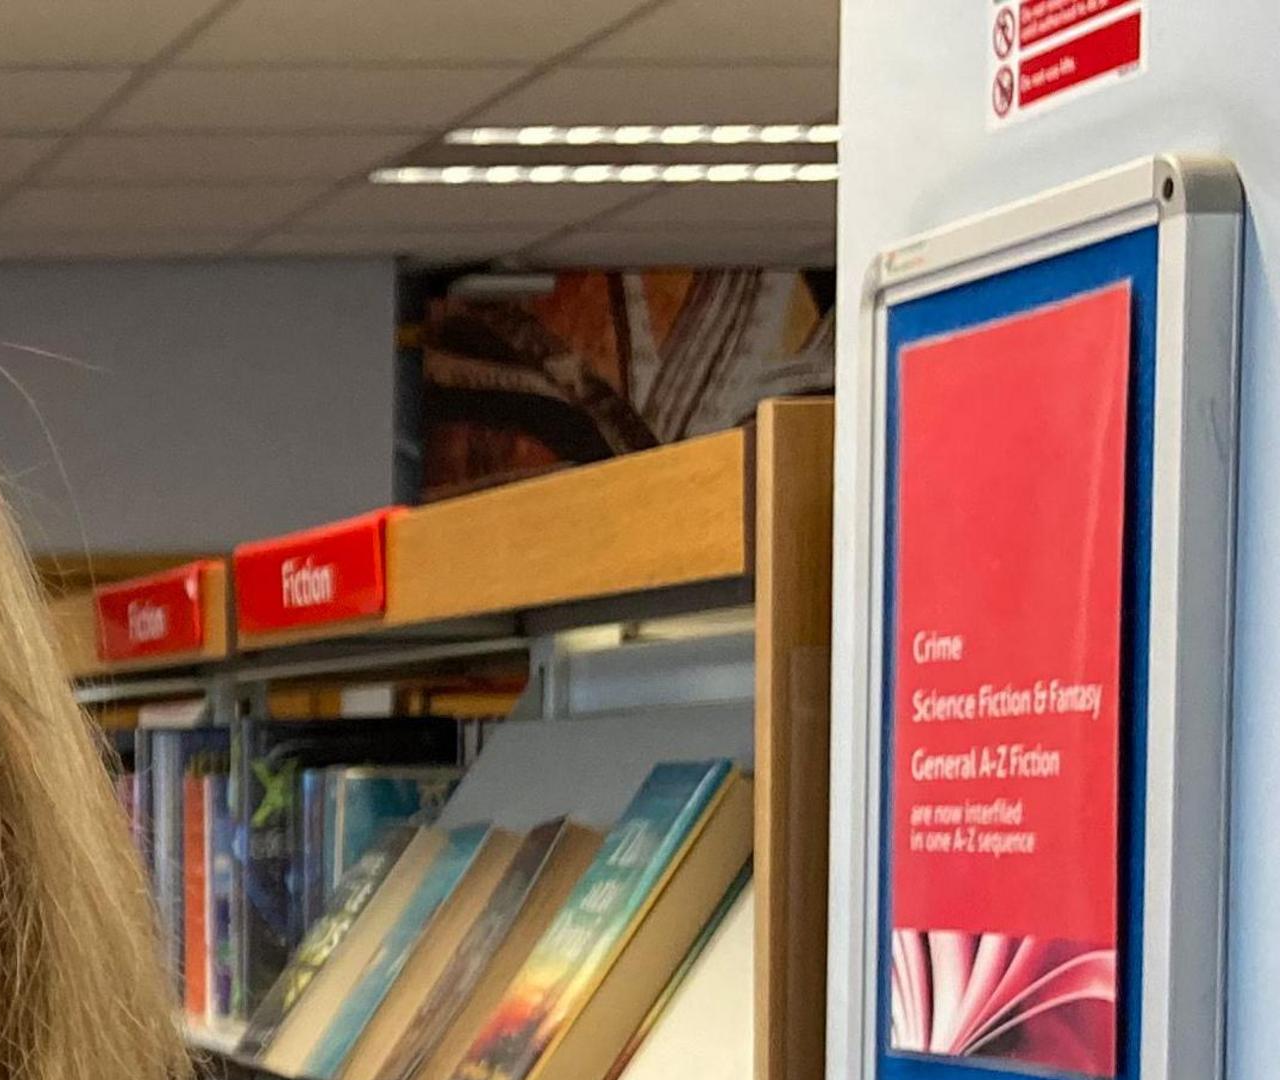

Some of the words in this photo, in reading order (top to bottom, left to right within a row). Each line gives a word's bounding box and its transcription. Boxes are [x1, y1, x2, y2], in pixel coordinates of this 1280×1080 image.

[281, 555, 332, 608] Fiction
[128, 599, 167, 642] Fiction
[913, 630, 963, 664] Crime
[912, 689, 976, 723] Science
[978, 682, 1032, 719] Fiction
[1033, 680, 1047, 715] &
[1049, 679, 1102, 720] Fantasy
[911, 747, 976, 781] General
[979, 745, 1008, 779] A-Z
[1009, 743, 1060, 778] Fiction
[910, 805, 933, 826] are
[933, 804, 962, 825] now
[964, 799, 1023, 825] interfiled
[909, 828, 923, 852] in
[925, 832, 951, 853] one
[952, 826, 976, 853] A-Z
[978, 831, 1035, 859] sequence
